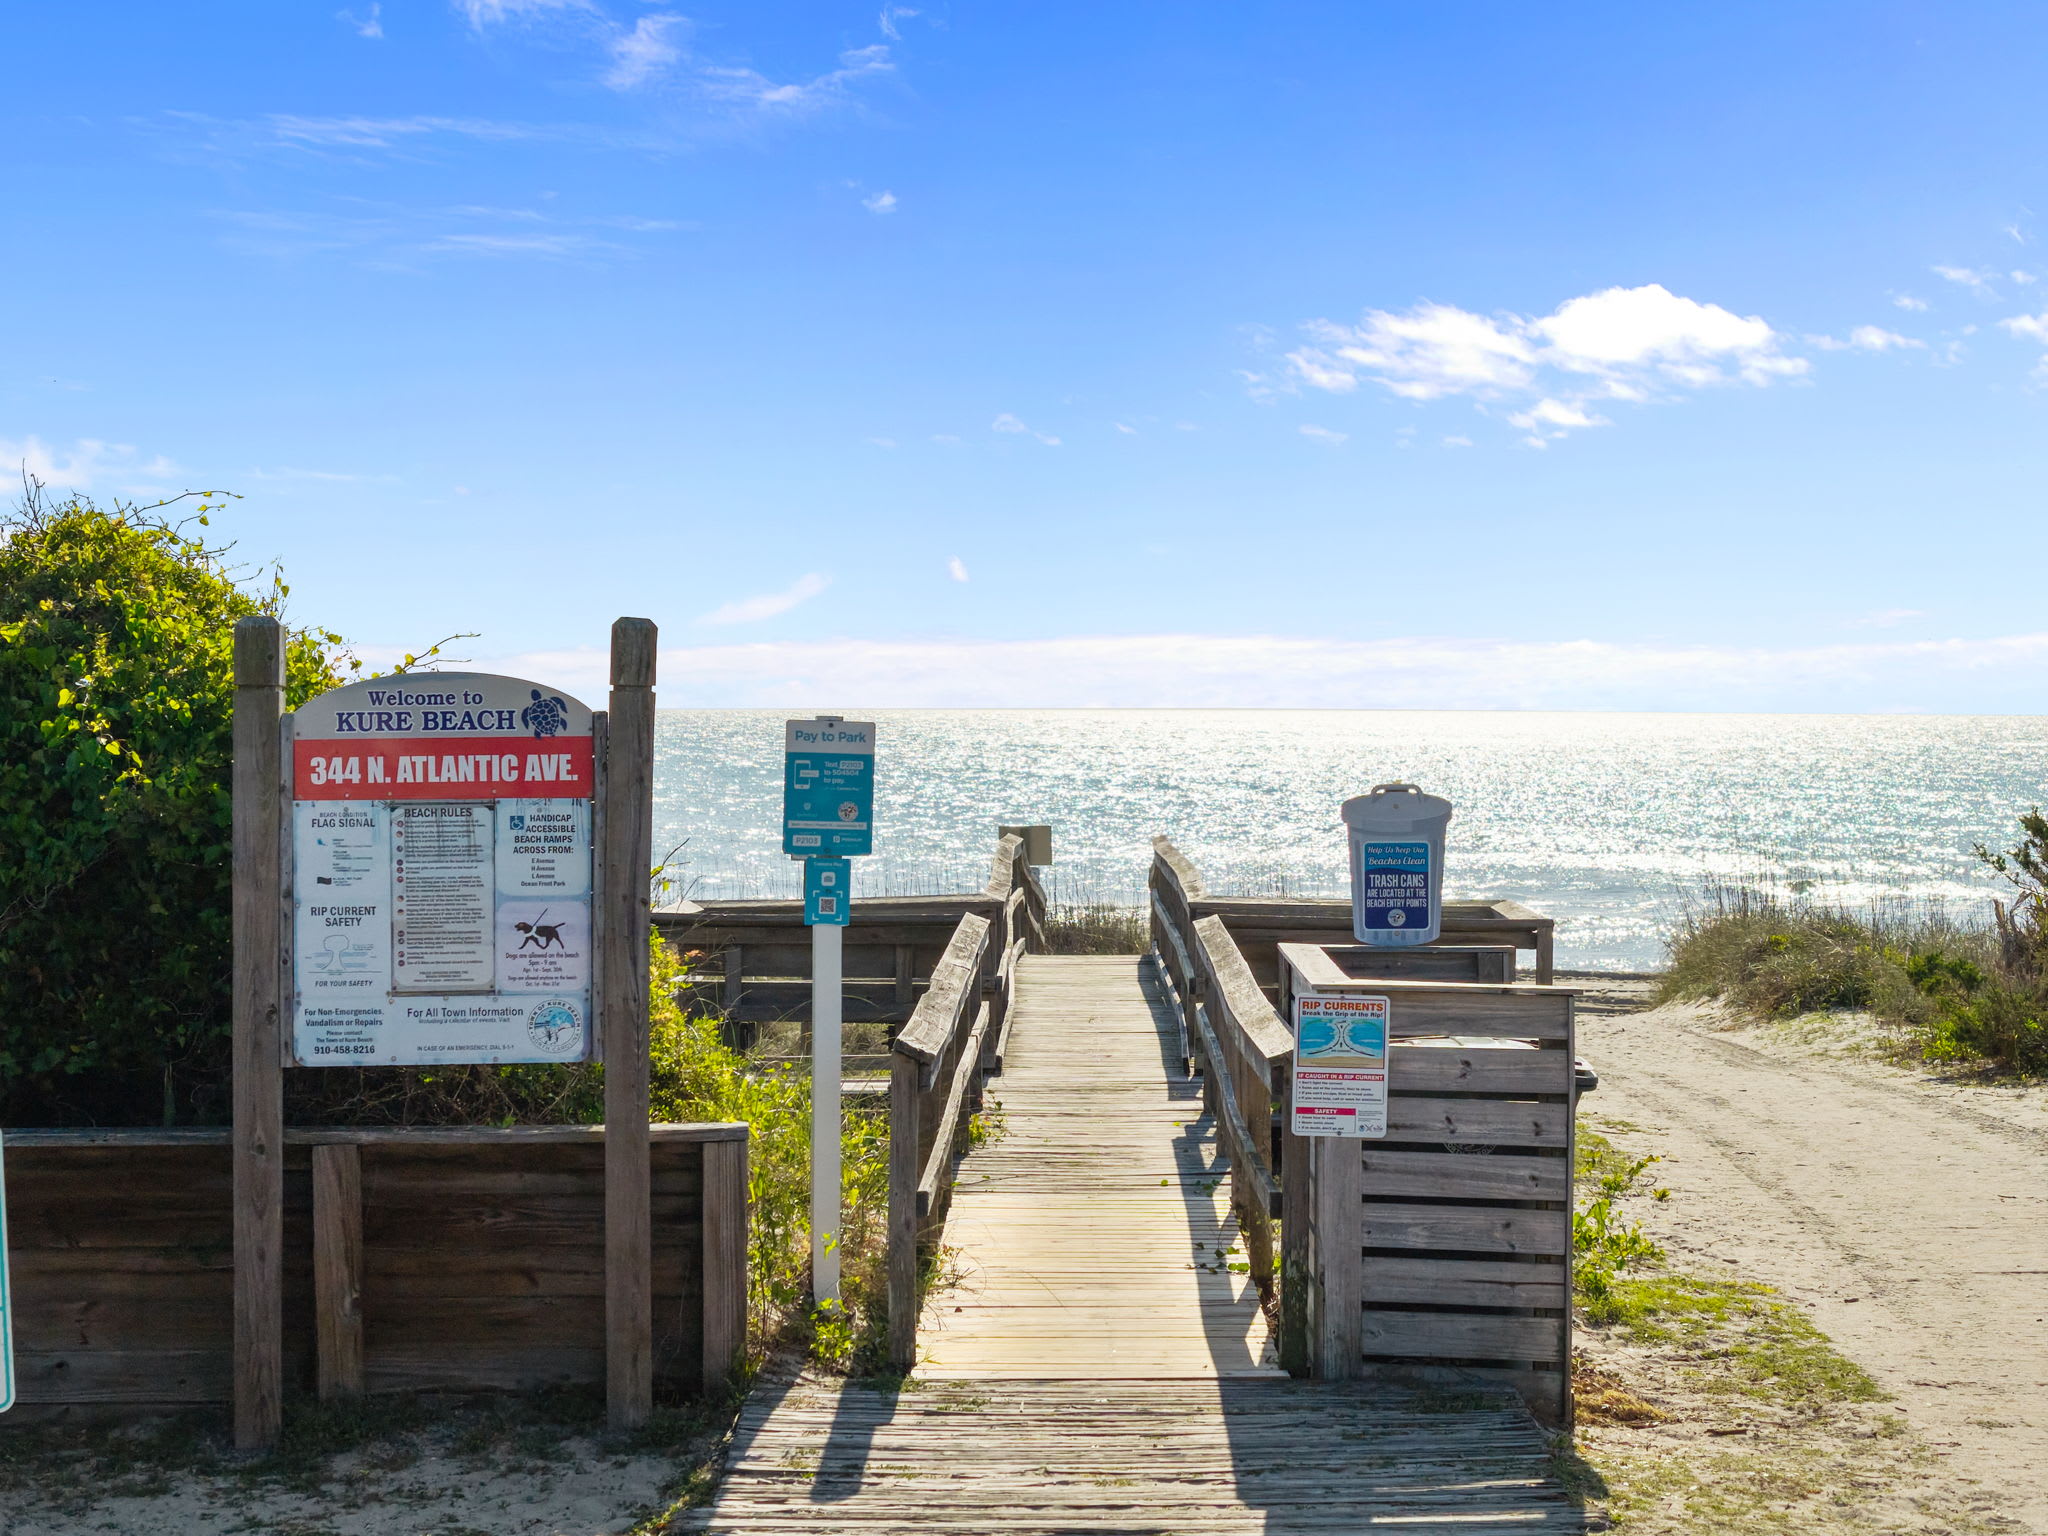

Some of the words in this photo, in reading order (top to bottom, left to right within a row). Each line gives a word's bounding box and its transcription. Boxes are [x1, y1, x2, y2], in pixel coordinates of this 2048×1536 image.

[368, 690, 456, 706] Welcome
[463, 690, 483, 705] to
[336, 711, 413, 732] KURE
[422, 710, 516, 731] BEACH
[796, 731, 818, 743] Pay
[822, 732, 834, 742] to
[838, 732, 866, 743] Park
[310, 756, 361, 784] 344
[368, 756, 391, 783] N.
[396, 754, 518, 782] ATLANTIC
[524, 753, 578, 781] AVE.
[405, 808, 437, 817] BEACH
[441, 808, 472, 817] RULES
[312, 819, 335, 827] FLAG
[339, 819, 375, 827] SIGNAL
[1369, 874, 1398, 887] TRASH
[1401, 874, 1424, 887] CANS
[1367, 889, 1378, 897] ARE
[1380, 889, 1405, 897] LOCATED
[1406, 889, 1414, 897] AT
[1416, 889, 1426, 897] THE
[1367, 899, 1385, 907] BEACH
[1387, 899, 1405, 907] ENTRY
[1406, 899, 1426, 907] POINTS
[311, 907, 327, 916] RIP
[330, 906, 376, 915] CURRENT
[325, 918, 362, 926] SAFETY
[1302, 1001, 1321, 1009] RIP
[1324, 1002, 1383, 1011] CURRENTS
[407, 1008, 423, 1017] For
[426, 1008, 438, 1017] All
[441, 1008, 466, 1017] Town
[469, 1007, 524, 1016] Information
[355, 1018, 383, 1027] Repairs
[529, 1011, 538, 1030] TOWN
[568, 1007, 580, 1027] BEACH
[314, 1046, 375, 1054] 910-458-8216
